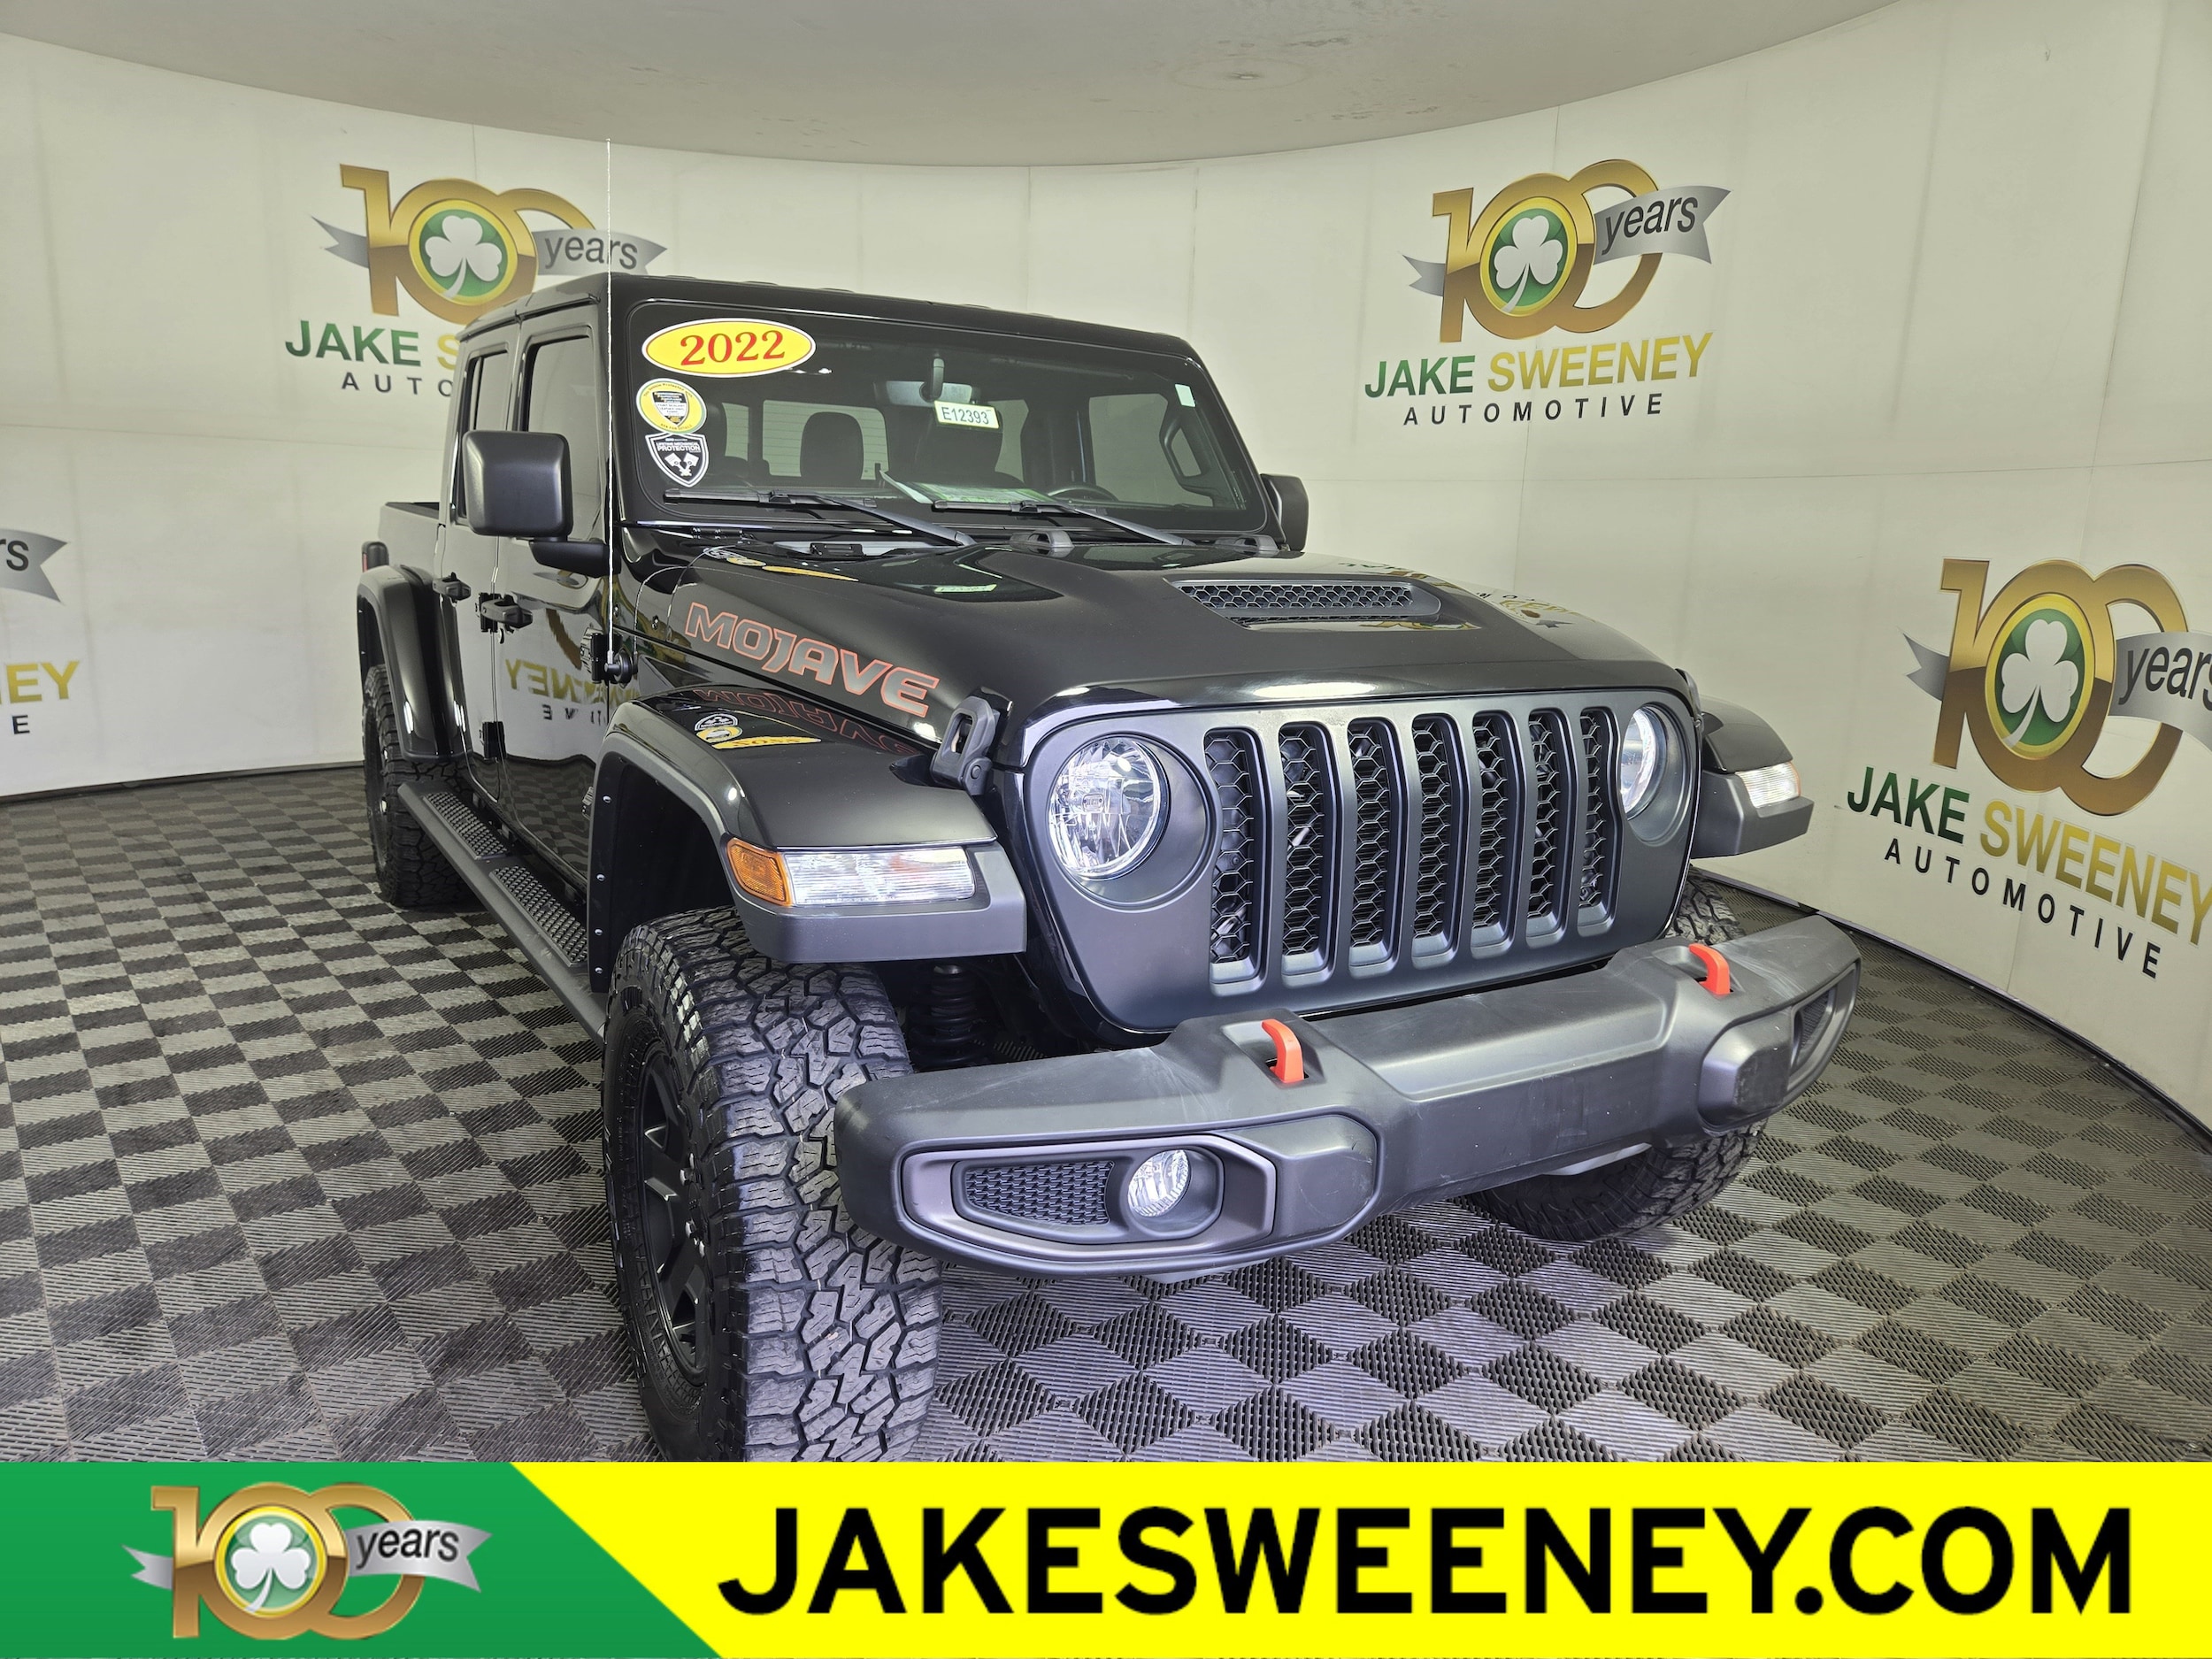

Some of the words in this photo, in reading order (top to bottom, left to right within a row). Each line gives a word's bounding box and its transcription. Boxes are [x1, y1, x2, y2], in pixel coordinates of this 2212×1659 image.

[543, 235, 639, 269] years
[1432, 158, 1663, 343] 100
[1601, 196, 1699, 257] years
[285, 320, 421, 366] JAKE
[680, 330, 786, 365] 2022
[1364, 356, 1476, 398] JAKE
[1487, 332, 1713, 392] SWEENEY
[941, 406, 989, 425] E12393
[1403, 393, 1663, 426] AUTOMOTIVE
[685, 602, 940, 718] MOJAVE
[1933, 558, 2188, 816] 100
[1847, 766, 1970, 844] JAKE
[1980, 800, 2212, 946] SWEENEY
[1885, 839, 2162, 979] AUTOMOTIVE
